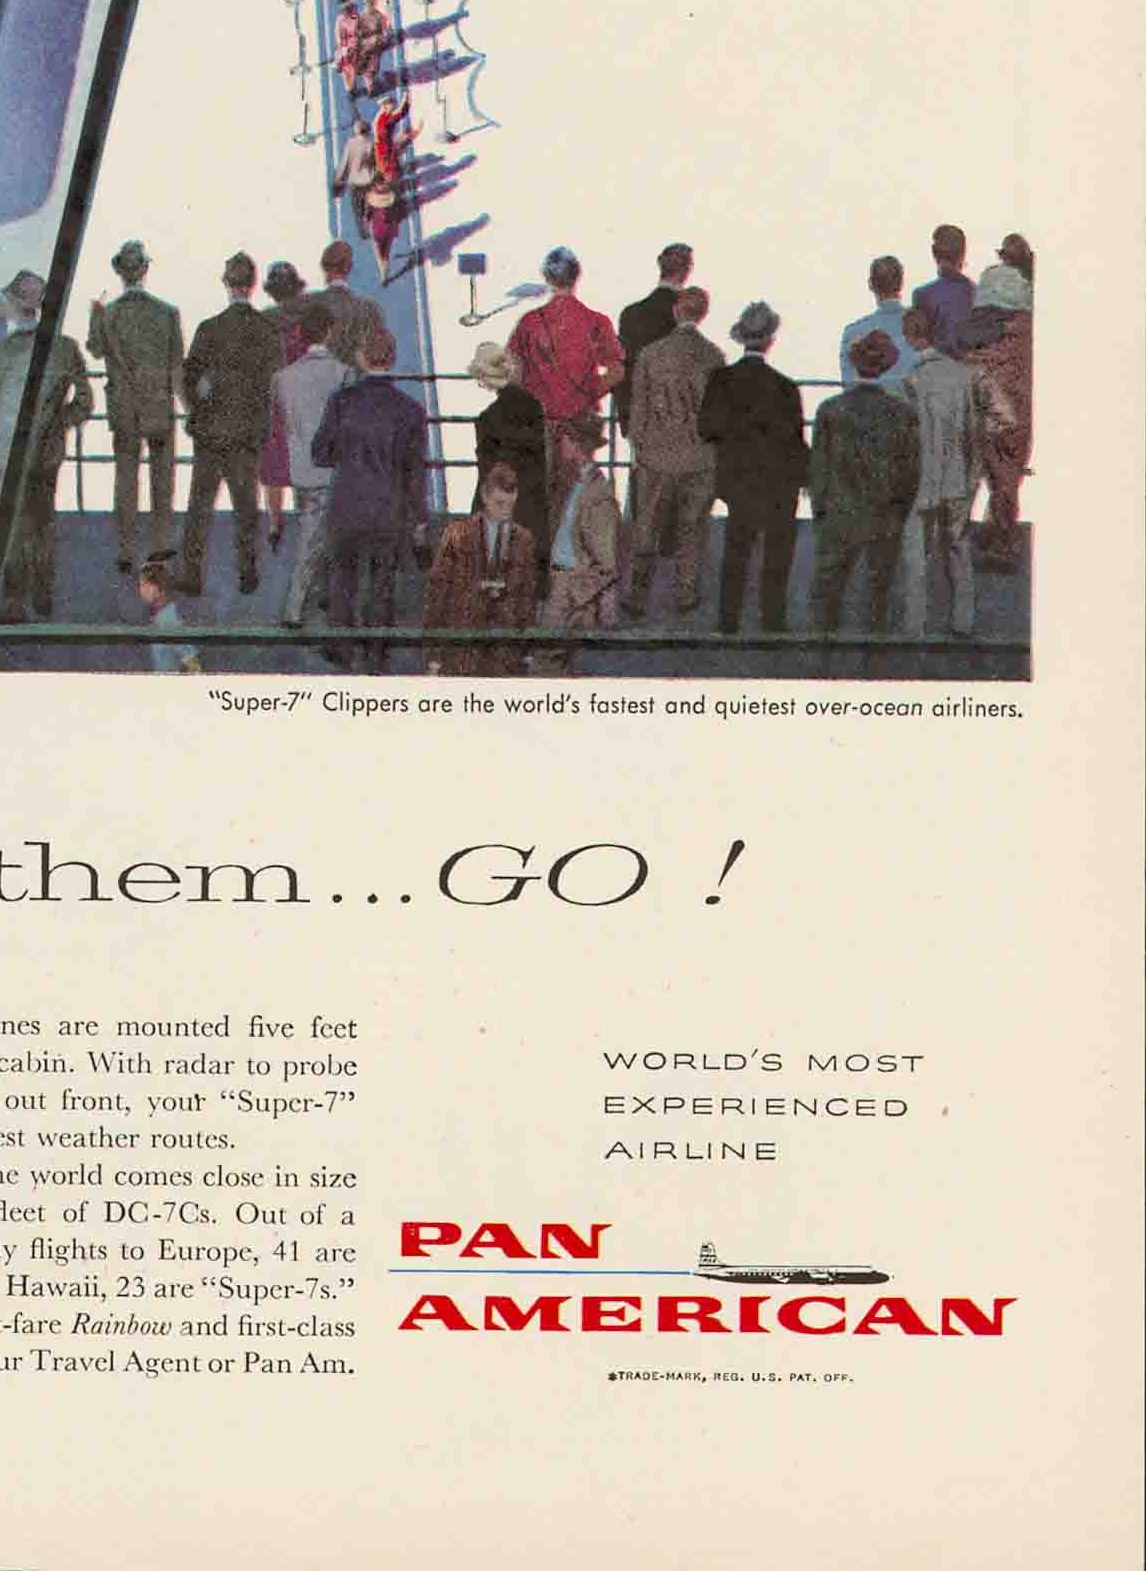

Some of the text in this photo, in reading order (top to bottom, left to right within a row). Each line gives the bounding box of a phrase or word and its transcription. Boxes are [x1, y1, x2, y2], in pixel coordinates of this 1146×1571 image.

[208, 690, 1023, 721] "Super-7" Clippers are the world's fastest and quietest over-ocean airliners.
[58, 1020, 99, 1037] are
[117, 1014, 230, 1038] mounted
[248, 1014, 295, 1038] five
[311, 1015, 358, 1039] feet
[603, 1048, 924, 1073] WORLD'S MOST
[5, 1092, 46, 1110] out
[61, 1087, 131, 1113] front,
[147, 1093, 207, 1118] your
[220, 1089, 356, 1120] "Super-7"
[604, 1096, 908, 1117] EXPERIENCED
[37, 1124, 141, 1149] weather
[151, 1132, 235, 1150] routes.
[605, 1141, 776, 1161] AIRLINE
[62, 1200, 90, 1223] of
[104, 1200, 217, 1225] DC-7Cs.
[235, 1201, 287, 1225] Out
[300, 1203, 327, 1225] of
[341, 1210, 355, 1226] a
[30, 1236, 108, 1267] flights
[121, 1243, 145, 1261] to
[158, 1238, 259, 1269] Europe,
[272, 1240, 298, 1262] 41
[315, 1247, 357, 1264] are
[400, 1221, 613, 1260] PAN
[70, 1312, 172, 1336] Rainbow
[180, 1313, 229, 1337] and
[237, 1313, 356, 1338] first-class
[397, 1294, 1018, 1337] AMERICAN
[29, 1348, 115, 1373] Travel
[123, 1350, 201, 1379] Agent
[207, 1358, 236, 1374] or
[243, 1351, 292, 1374] Pan
[299, 1351, 355, 1375] Am.
